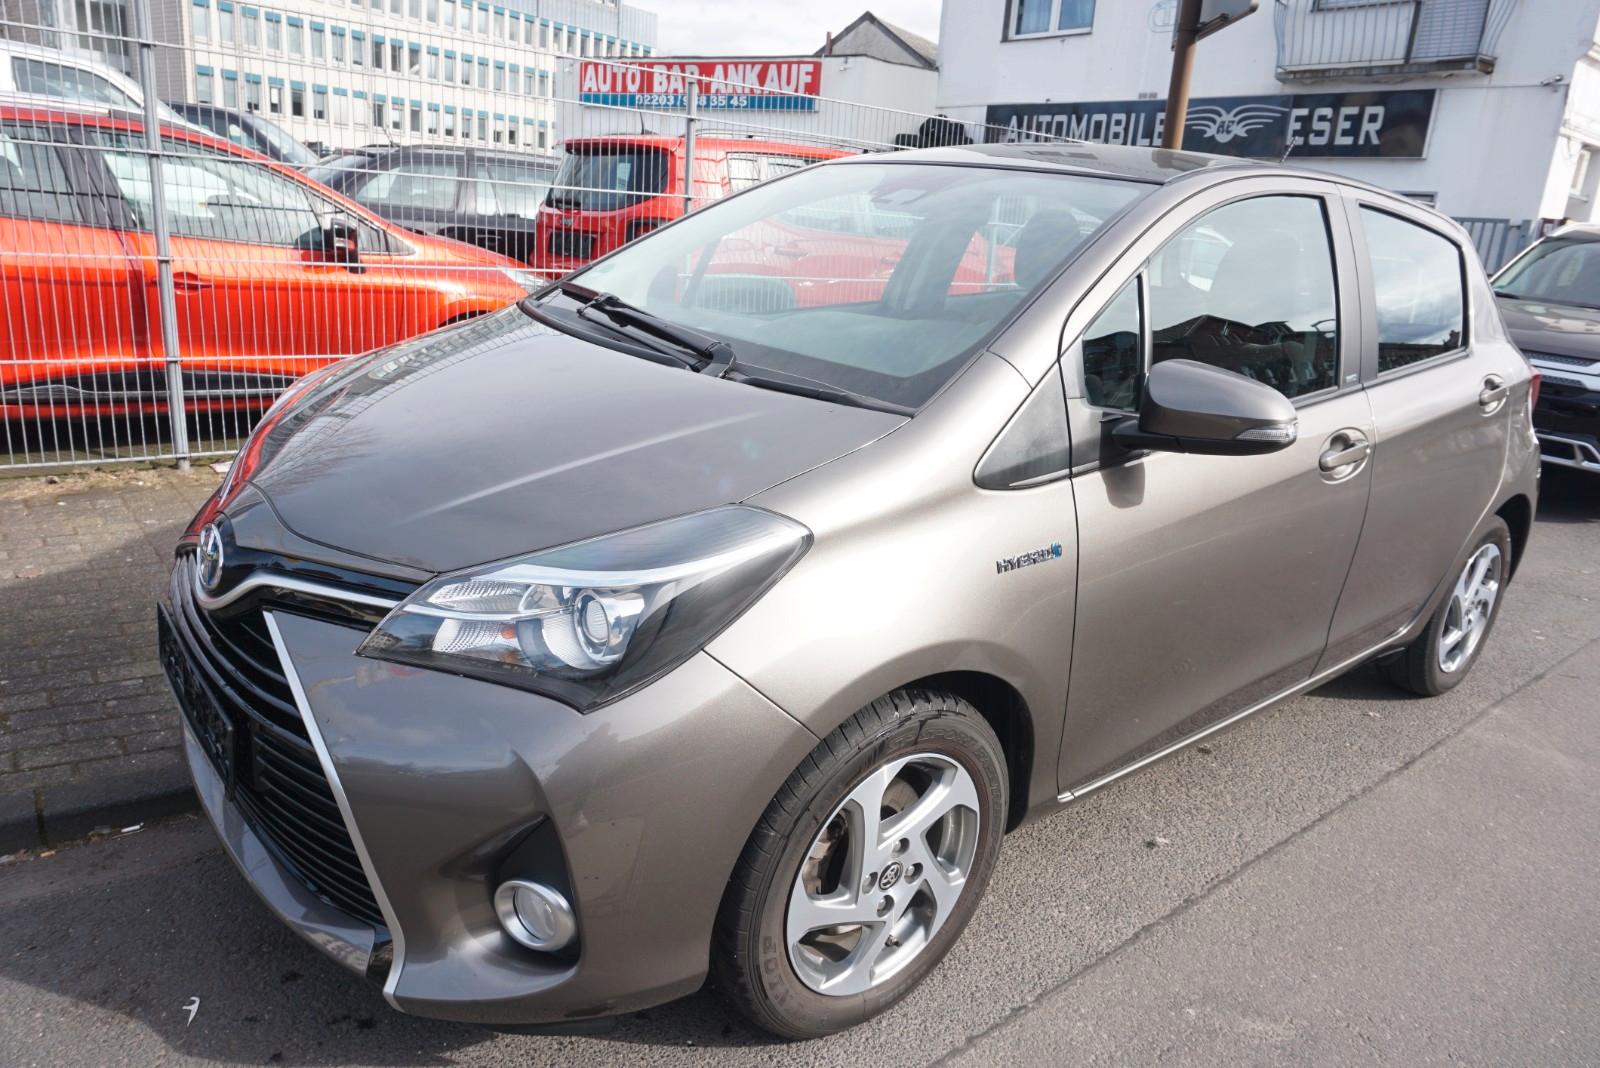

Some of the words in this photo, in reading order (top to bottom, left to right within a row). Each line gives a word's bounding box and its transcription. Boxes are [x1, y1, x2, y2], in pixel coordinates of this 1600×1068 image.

[583, 64, 640, 92] AUTO
[711, 63, 814, 94] ANKAUF
[1287, 106, 1385, 145] ESER
